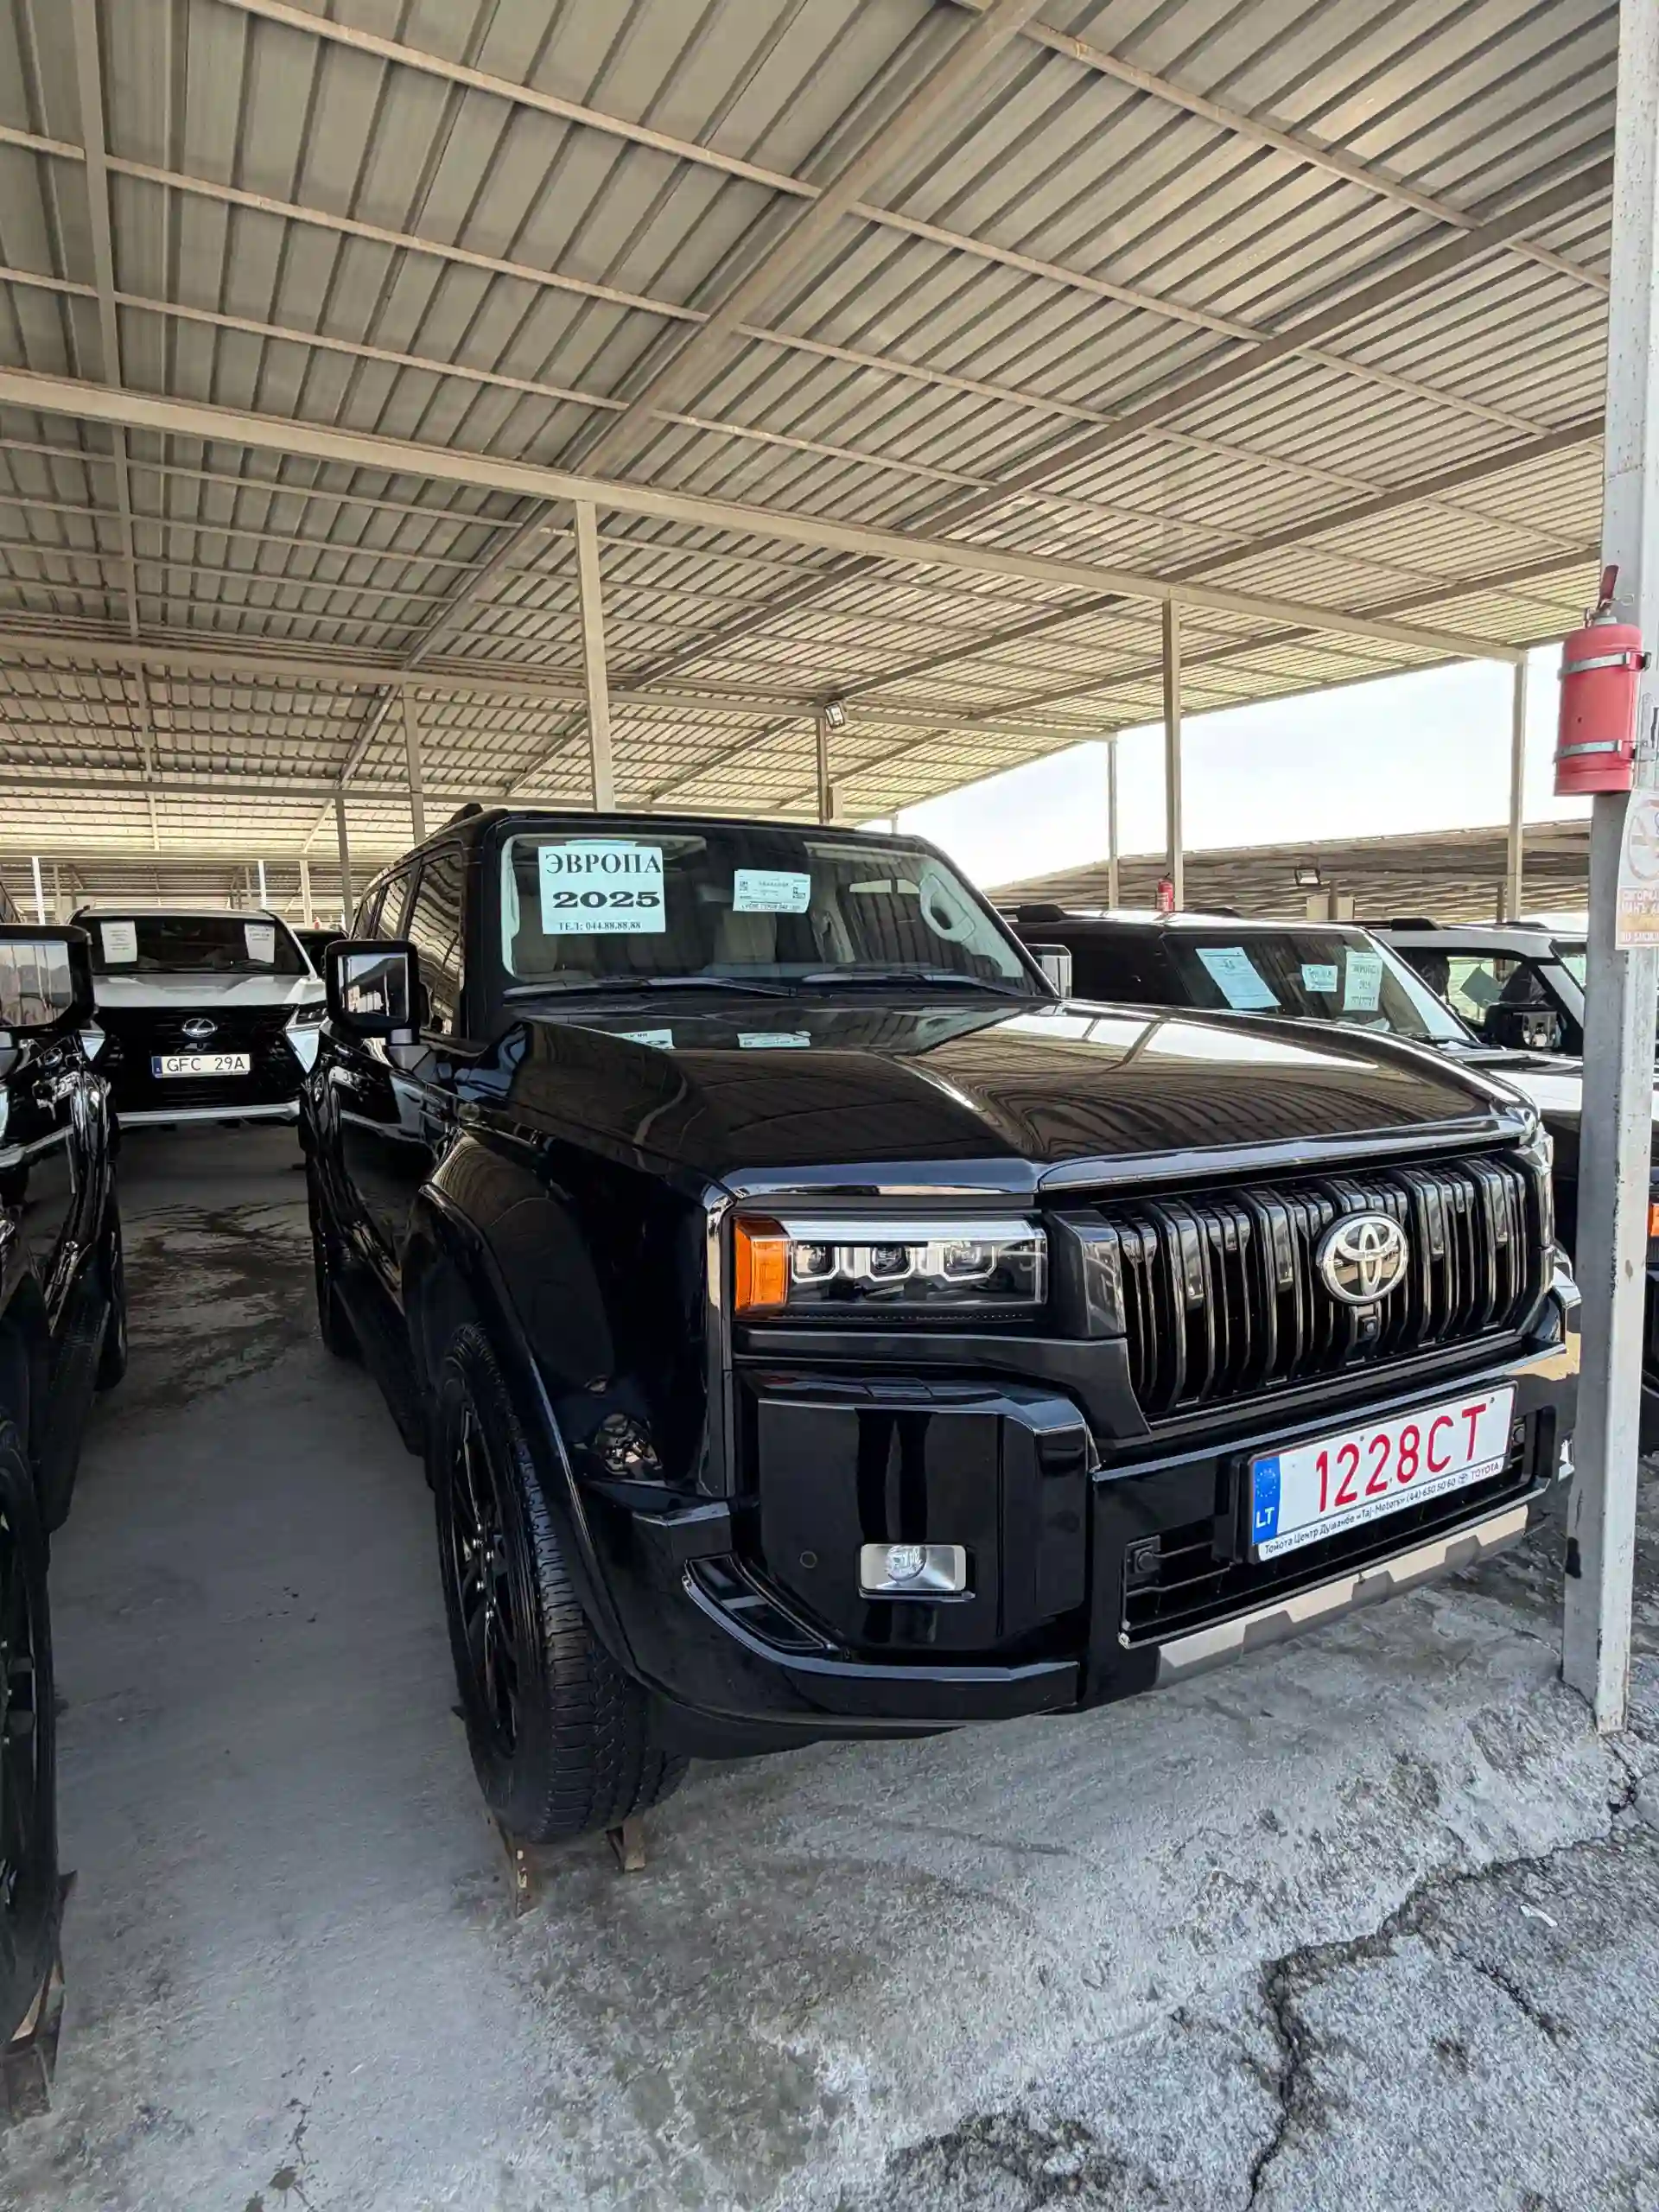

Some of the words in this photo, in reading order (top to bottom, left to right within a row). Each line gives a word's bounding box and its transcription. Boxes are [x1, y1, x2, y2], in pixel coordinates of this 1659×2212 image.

[545, 853, 662, 874] ЭВРОПА
[552, 891, 661, 908] 2025
[559, 921, 583, 931] ТЕЛ:
[167, 1057, 201, 1072] GFC
[214, 1056, 245, 1071] 29A
[1315, 1402, 1487, 1513] 1228CT
[1255, 1506, 1274, 1529] LT
[1265, 1538, 1293, 1554] Тойота
[1294, 1529, 1319, 1544] Центр
[1319, 1514, 1356, 1536] Душанбе
[1471, 1461, 1500, 1480] TOYOTA
